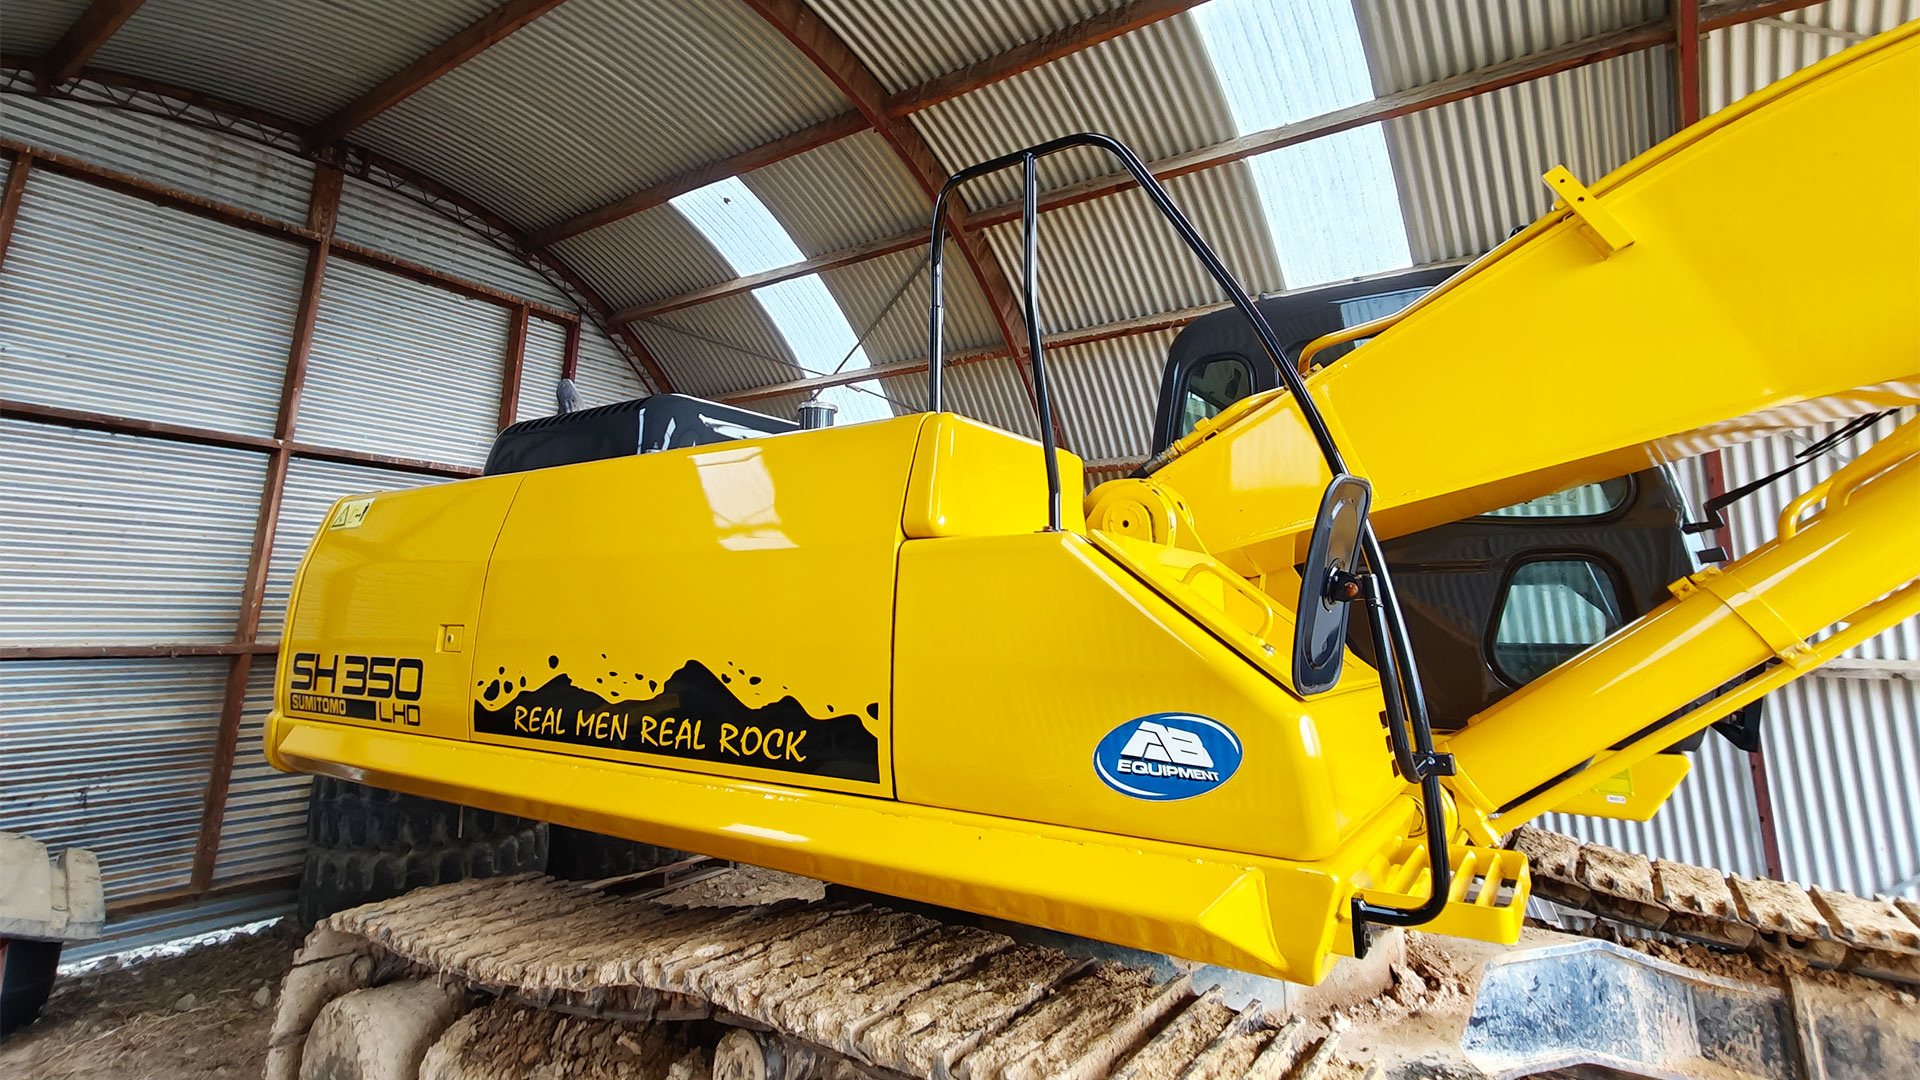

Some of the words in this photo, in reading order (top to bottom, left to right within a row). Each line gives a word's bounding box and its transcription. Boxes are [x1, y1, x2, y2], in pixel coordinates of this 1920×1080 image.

[291, 653, 339, 693] SH
[342, 656, 423, 701] 350
[292, 694, 347, 715] SUMITOMO
[514, 705, 565, 735] REAL
[576, 709, 629, 742] MEN
[640, 716, 706, 751] REAL
[719, 722, 807, 762] ROCK
[1120, 720, 1214, 769] AB
[1117, 758, 1220, 782] EQUIPMENT
